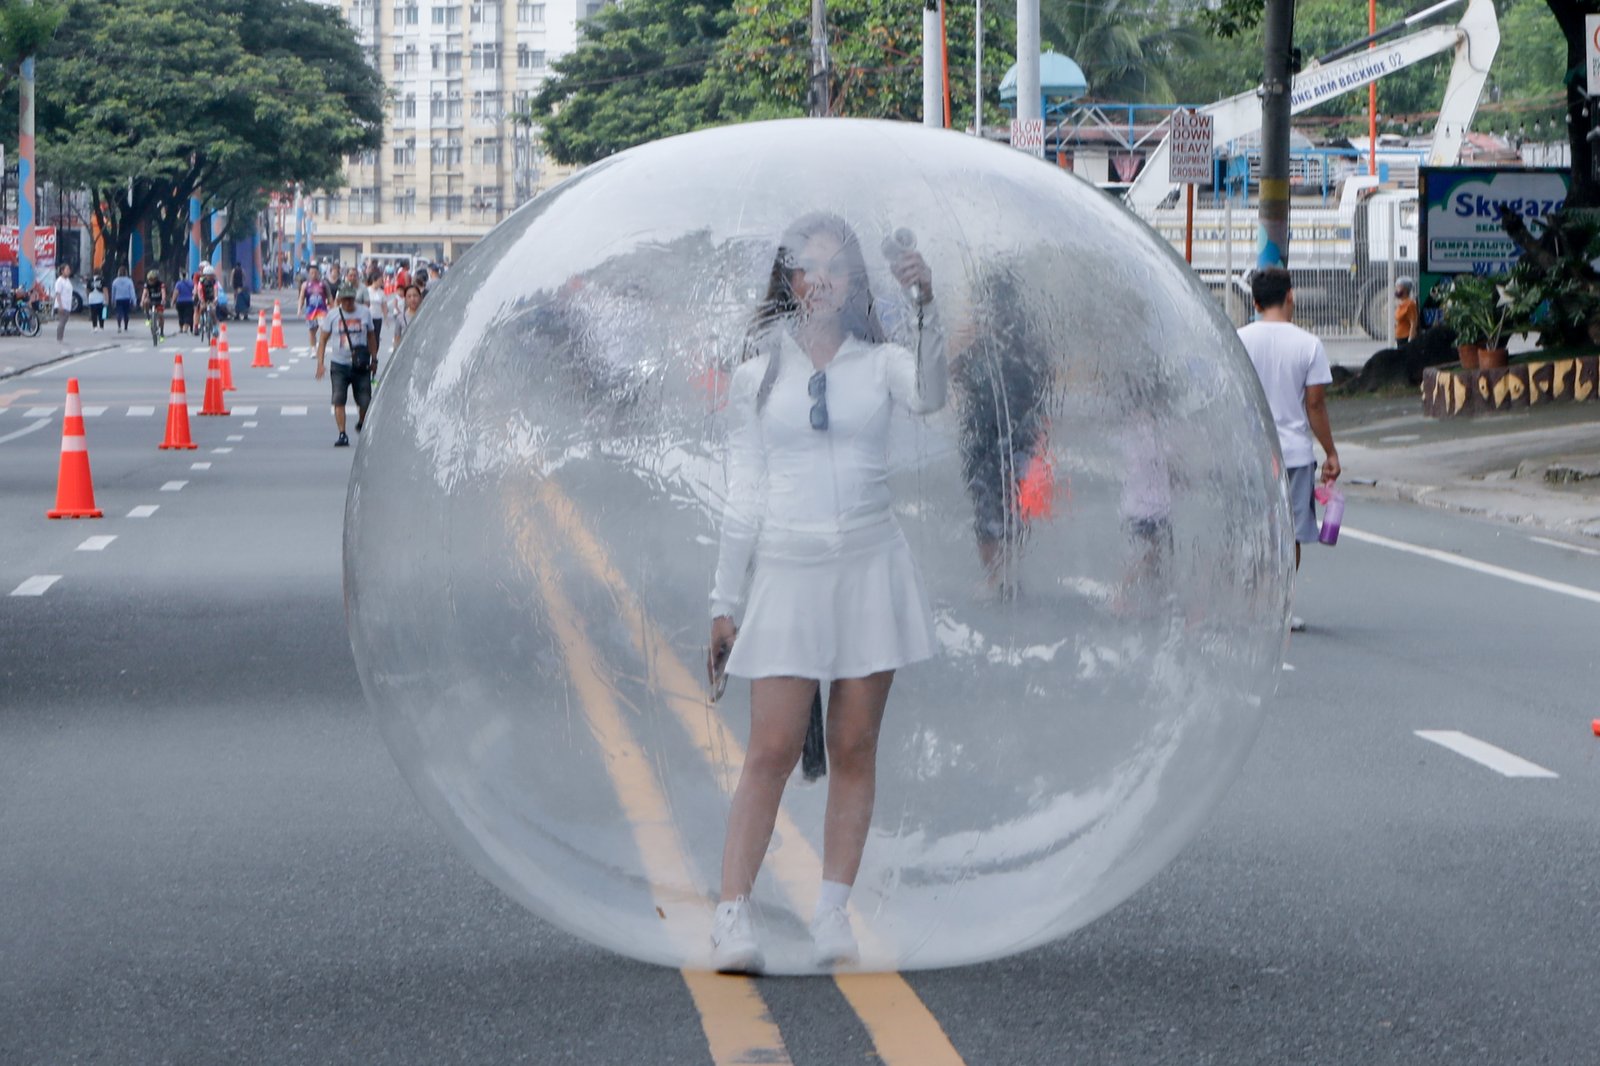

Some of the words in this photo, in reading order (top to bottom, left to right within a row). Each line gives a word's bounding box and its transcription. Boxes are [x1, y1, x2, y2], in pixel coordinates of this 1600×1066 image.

[1291, 91, 1312, 106] ONG
[1314, 82, 1338, 98] ARM
[1339, 62, 1386, 87] BACKHOE
[1389, 52, 1403, 68] 02
[1012, 121, 1042, 132] SLOW
[1173, 115, 1210, 127] SLOW
[1173, 129, 1210, 140] DOWN
[1012, 134, 1042, 147] DOWN
[1173, 142, 1209, 153] HEAVY
[1172, 155, 1209, 165] EQUIPMENT
[1172, 167, 1210, 177] CROSSING
[1291, 228, 1337, 240] RUCK
[1434, 241, 1469, 249] DAMPA
[1473, 241, 1512, 249] PALUTO
